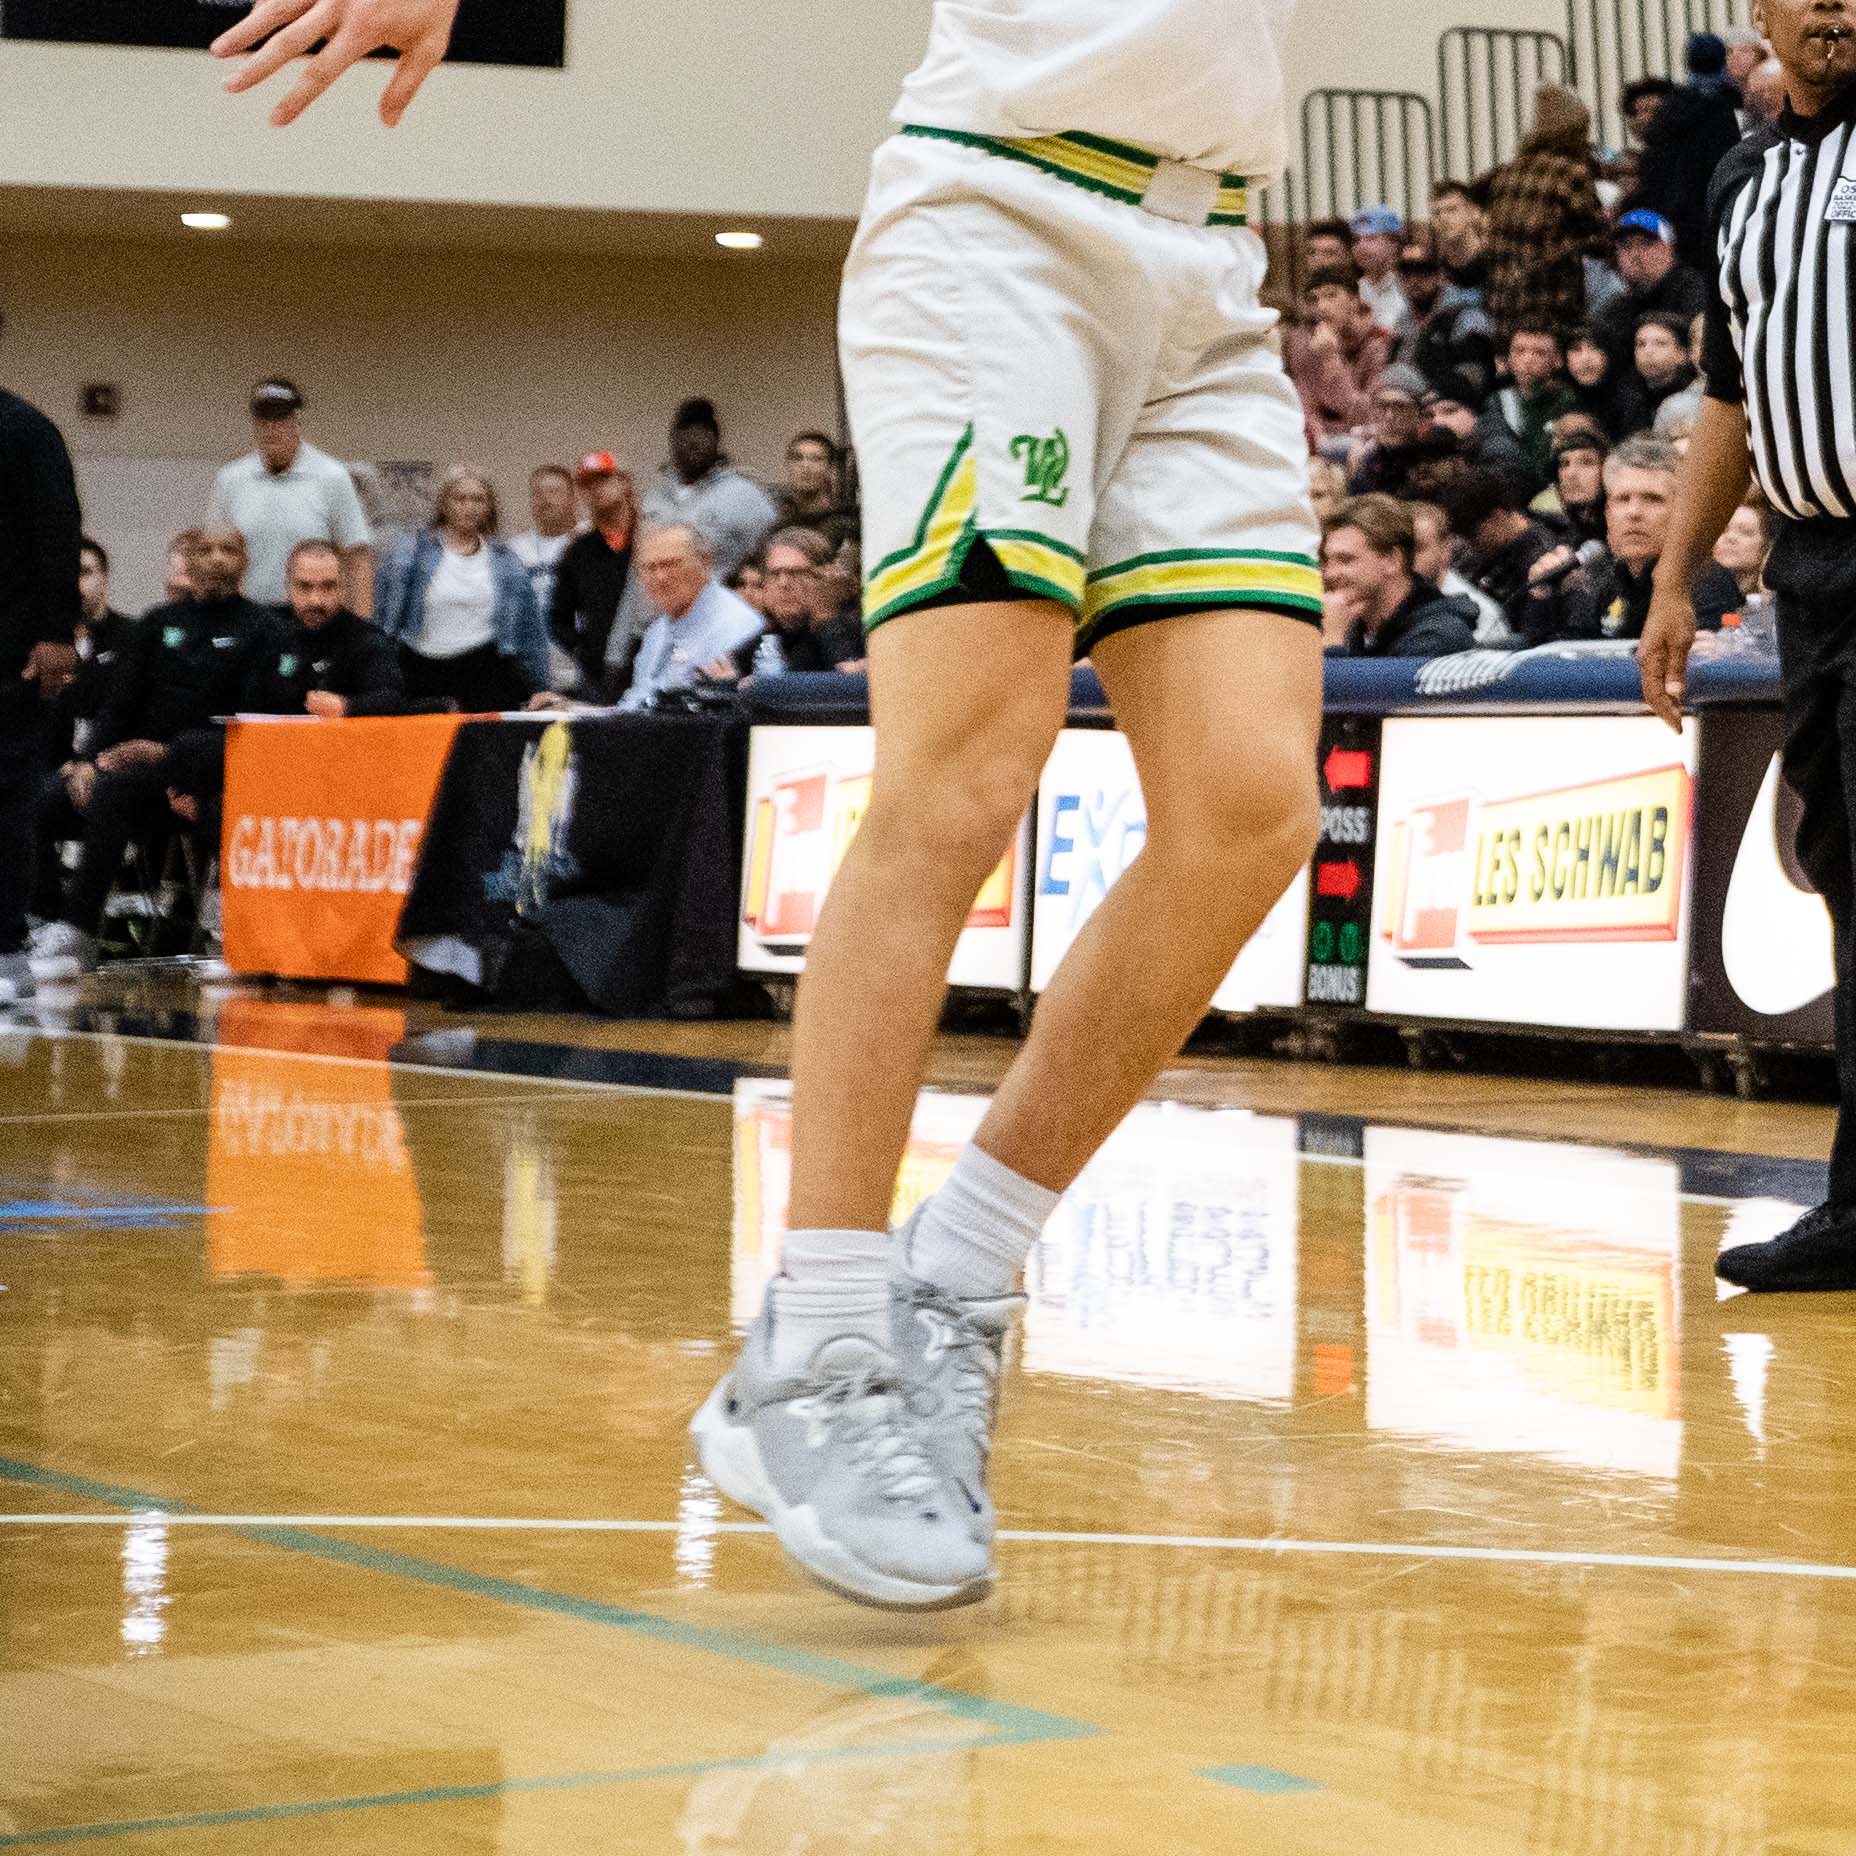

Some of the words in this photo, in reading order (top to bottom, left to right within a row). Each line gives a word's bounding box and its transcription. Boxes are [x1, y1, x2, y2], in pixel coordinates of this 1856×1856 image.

[228, 814, 422, 895] GATORADE
[1472, 827, 1522, 908] LES
[1529, 803, 1669, 905] SCHWAB
[1308, 963, 1362, 1003] BONUS
